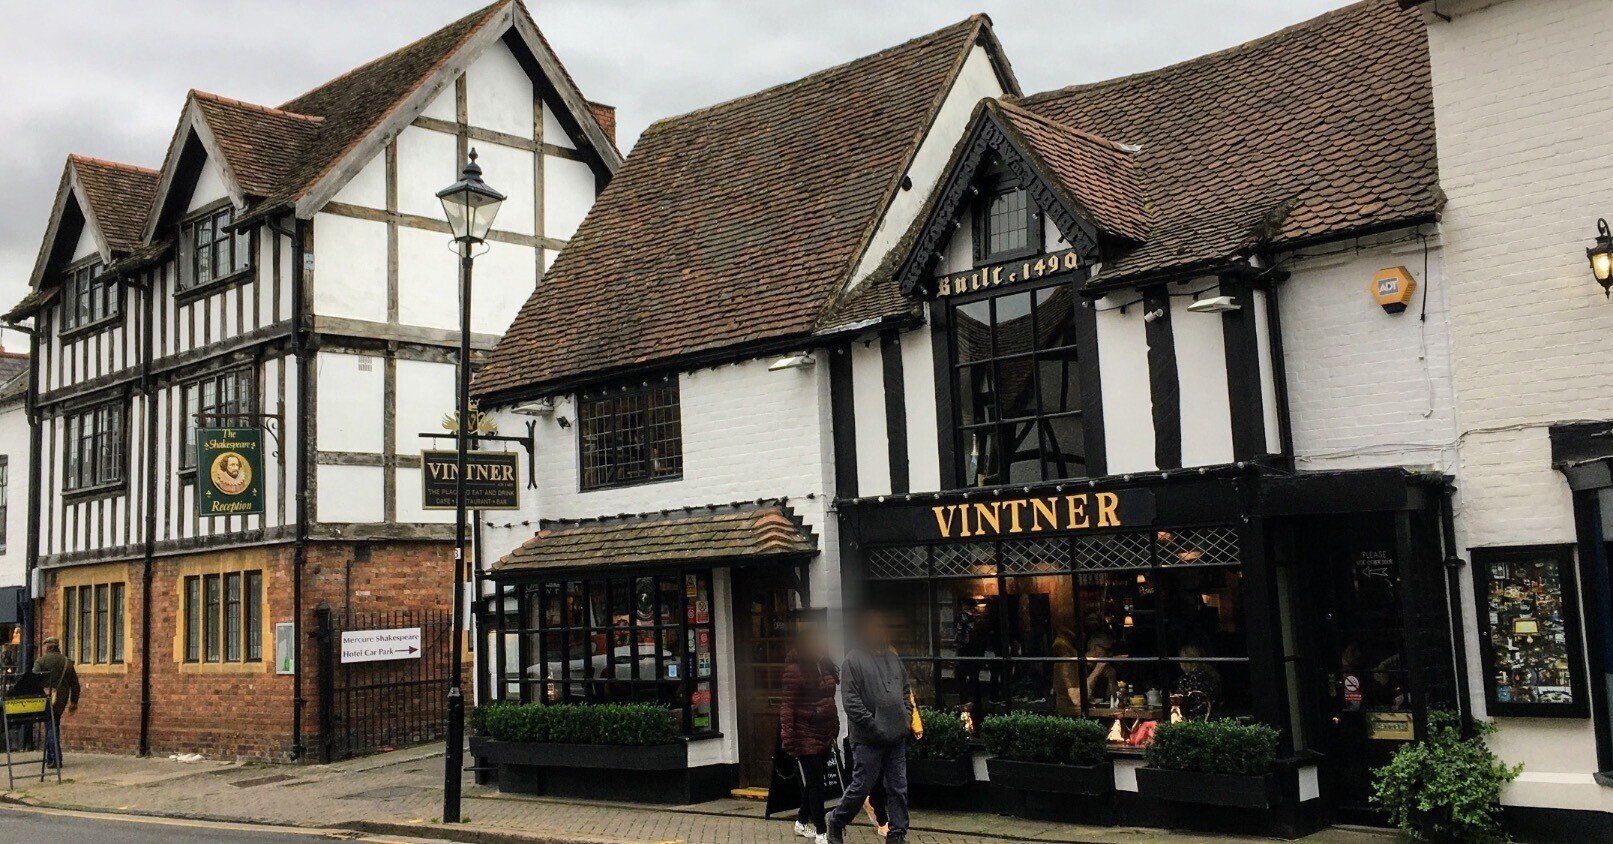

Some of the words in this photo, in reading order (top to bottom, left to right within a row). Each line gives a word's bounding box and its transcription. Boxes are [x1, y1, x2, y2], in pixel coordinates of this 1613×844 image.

[1023, 251, 1078, 280] 1490
[221, 428, 236, 438] The
[209, 439, 251, 450] Shakespeare
[427, 462, 515, 481] VINTNER
[212, 500, 252, 512] Reception
[932, 491, 1122, 538] VINTNER
[375, 634, 419, 642] Shakespeare
[343, 650, 363, 658] Hotel
[378, 647, 394, 655] Park
